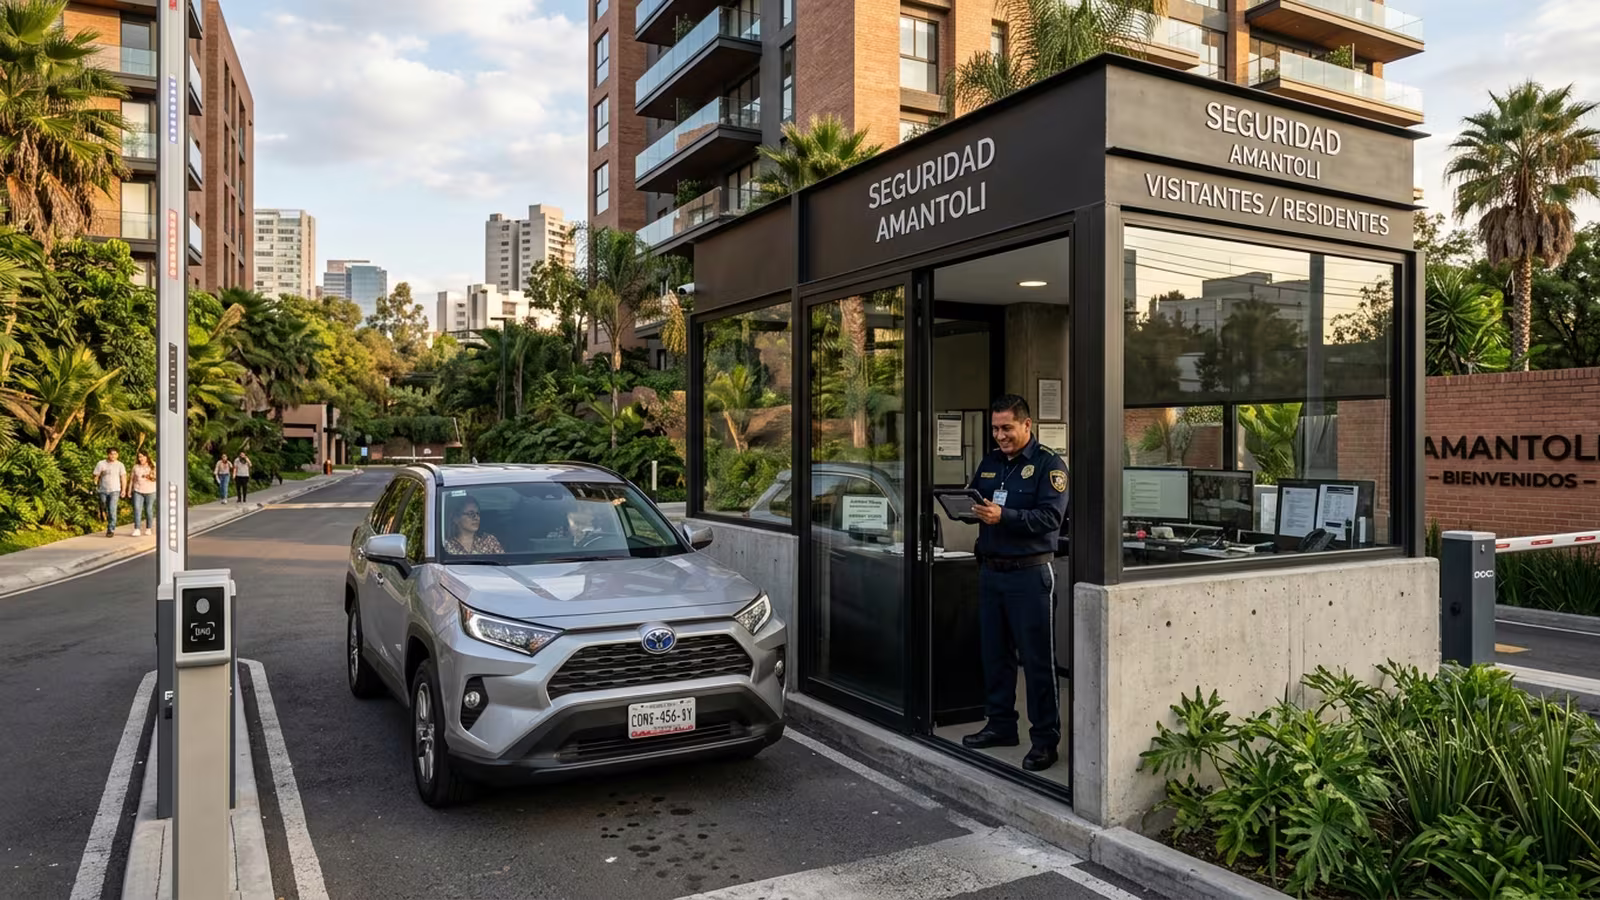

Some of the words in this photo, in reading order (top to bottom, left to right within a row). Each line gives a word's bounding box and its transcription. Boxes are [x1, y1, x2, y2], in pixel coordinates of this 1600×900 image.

[1206, 101, 1342, 156] SEGURIDAD
[868, 137, 996, 209] SEGURIDAD
[1229, 144, 1321, 180] AMANTOLI
[875, 181, 986, 243] AMANTOLI
[1145, 173, 1265, 215] VISITANTES
[1268, 196, 1279, 217] /
[1282, 198, 1390, 236] RESIDENTES
[1443, 470, 1578, 488] BIENVENIDOS
